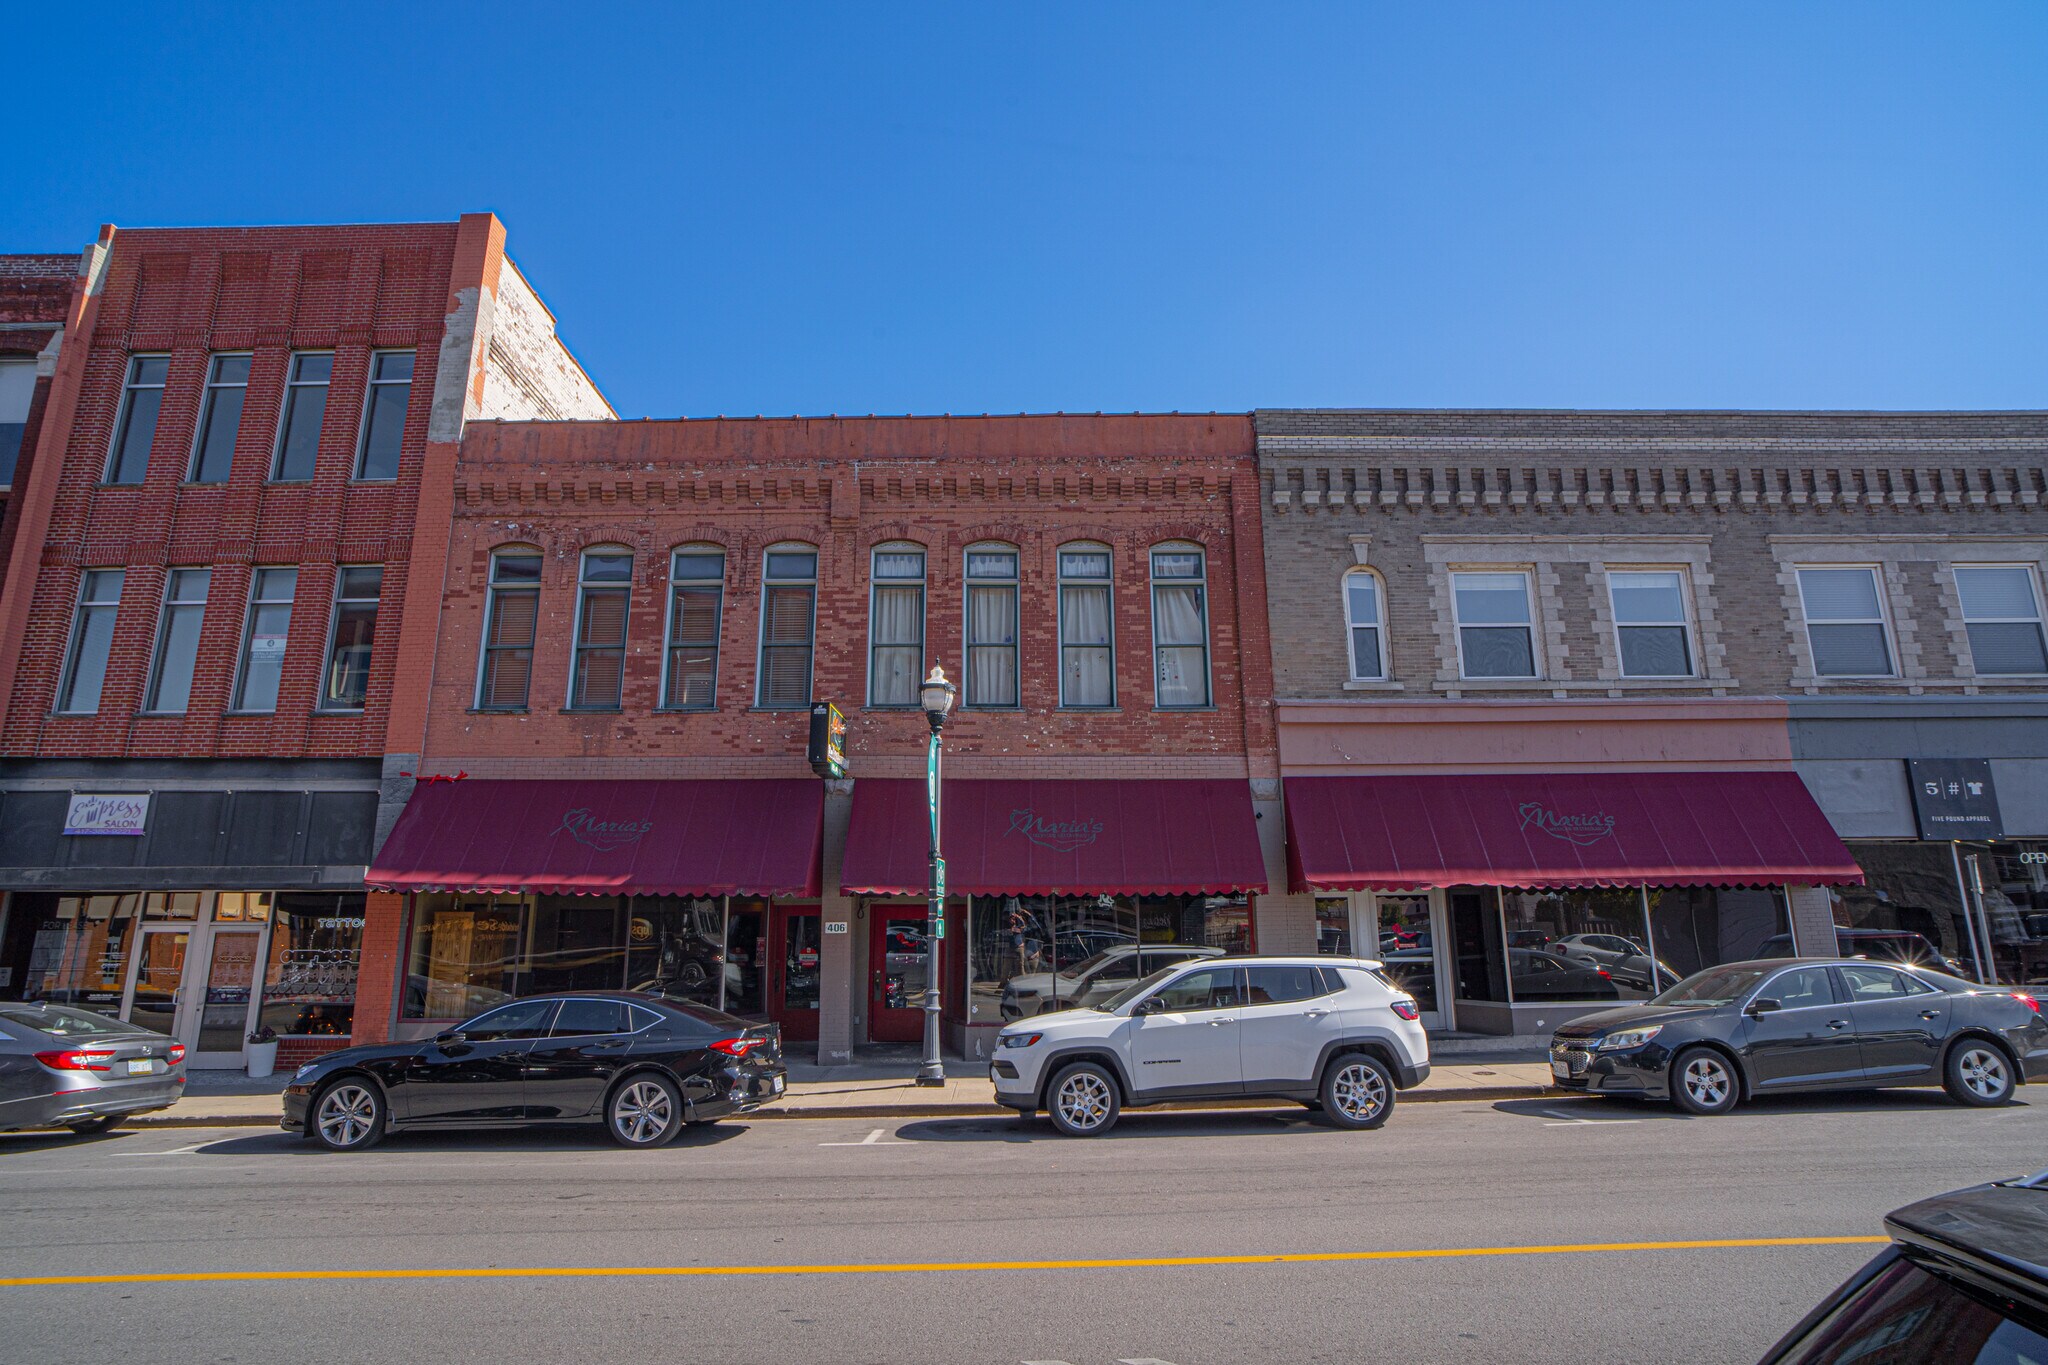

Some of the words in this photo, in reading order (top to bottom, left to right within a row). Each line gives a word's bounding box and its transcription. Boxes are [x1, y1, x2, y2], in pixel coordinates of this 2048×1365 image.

[1925, 782, 1939, 795] 5
[104, 820, 138, 828] SALON
[551, 810, 653, 834] Maria's
[1004, 811, 1104, 835] Maria's
[1520, 804, 1615, 832] Maria's
[42, 921, 61, 930] FOR
[827, 923, 846, 932] 406
